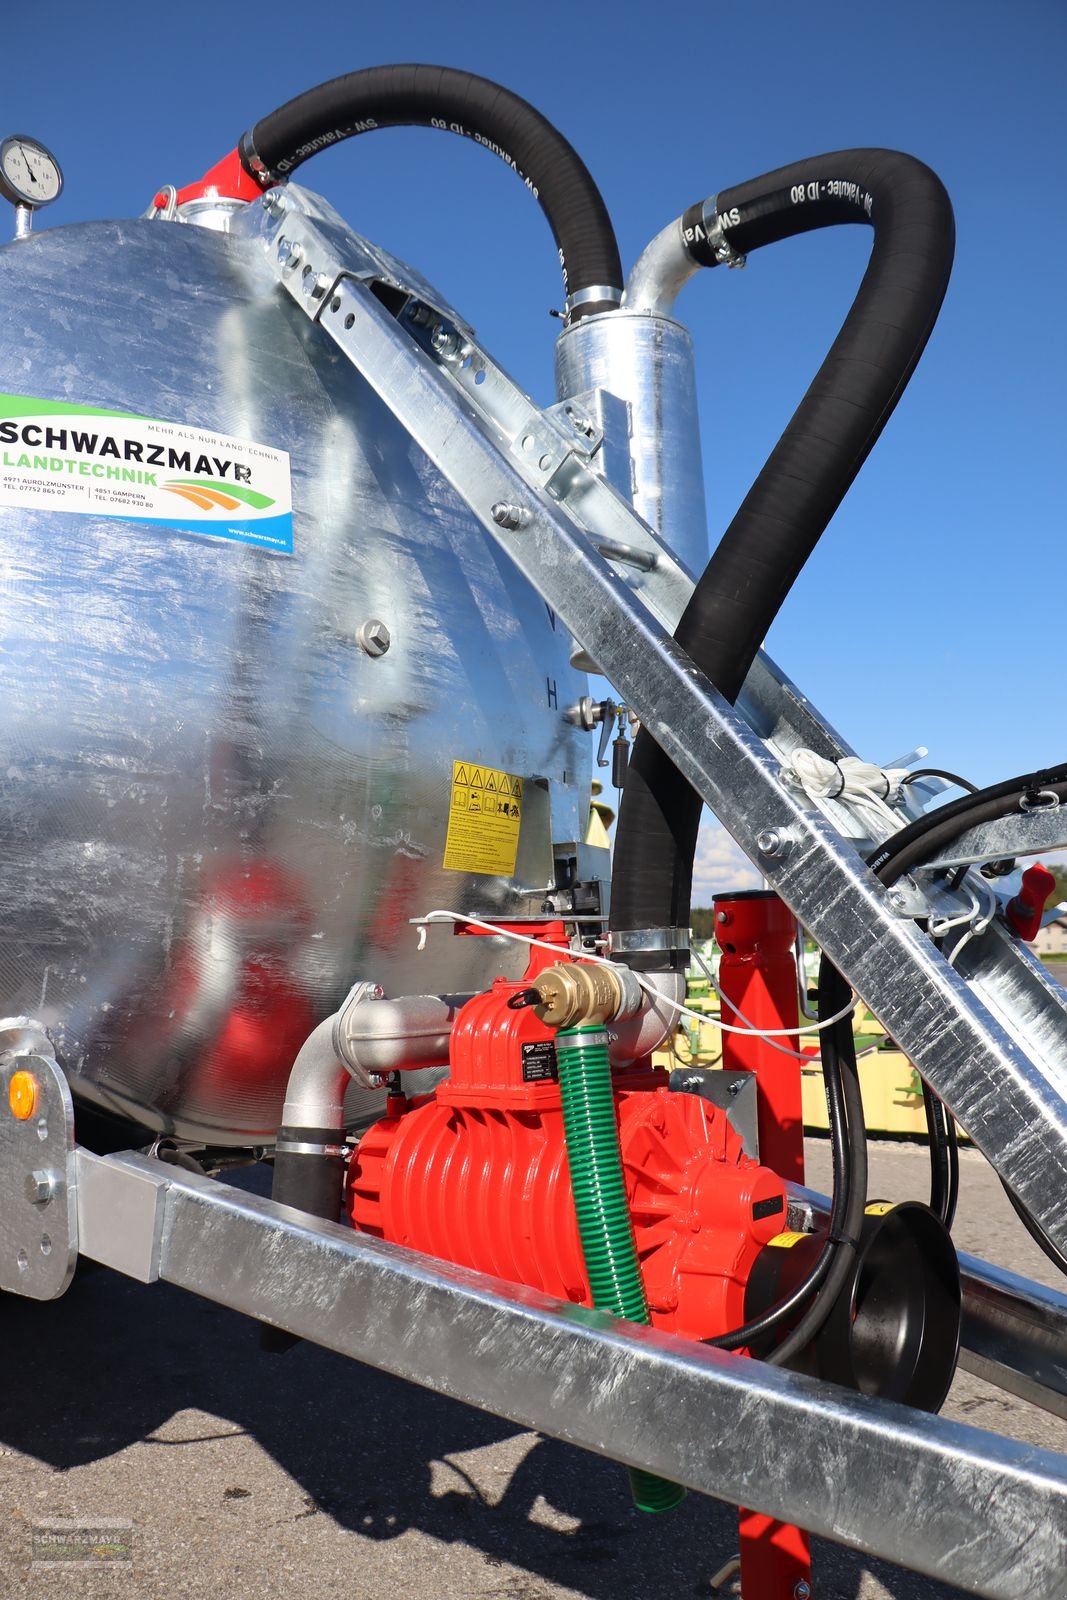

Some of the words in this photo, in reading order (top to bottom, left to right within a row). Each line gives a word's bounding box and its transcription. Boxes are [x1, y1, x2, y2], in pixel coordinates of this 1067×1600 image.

[354, 118, 378, 132] SW
[431, 117, 447, 129] 80
[450, 123, 464, 135] ID
[295, 129, 347, 156] Vakutec
[474, 132, 519, 172] Vakutec
[790, 184, 805, 204] 80
[807, 182, 819, 200] ID
[827, 180, 860, 205] Vakutec
[718, 207, 741, 230] SW
[147, 425, 174, 435] MEHR
[177, 431, 195, 440] ALS
[198, 435, 217, 445] NUR
[0, 421, 252, 484] SCHWARZMAYR
[3, 452, 158, 487] LANDTECHNIK
[19, 485, 41, 493] 07752
[112, 490, 146, 500] GAMPERN
[131, 499, 144, 507] 930
[546, 677, 558, 711] H
